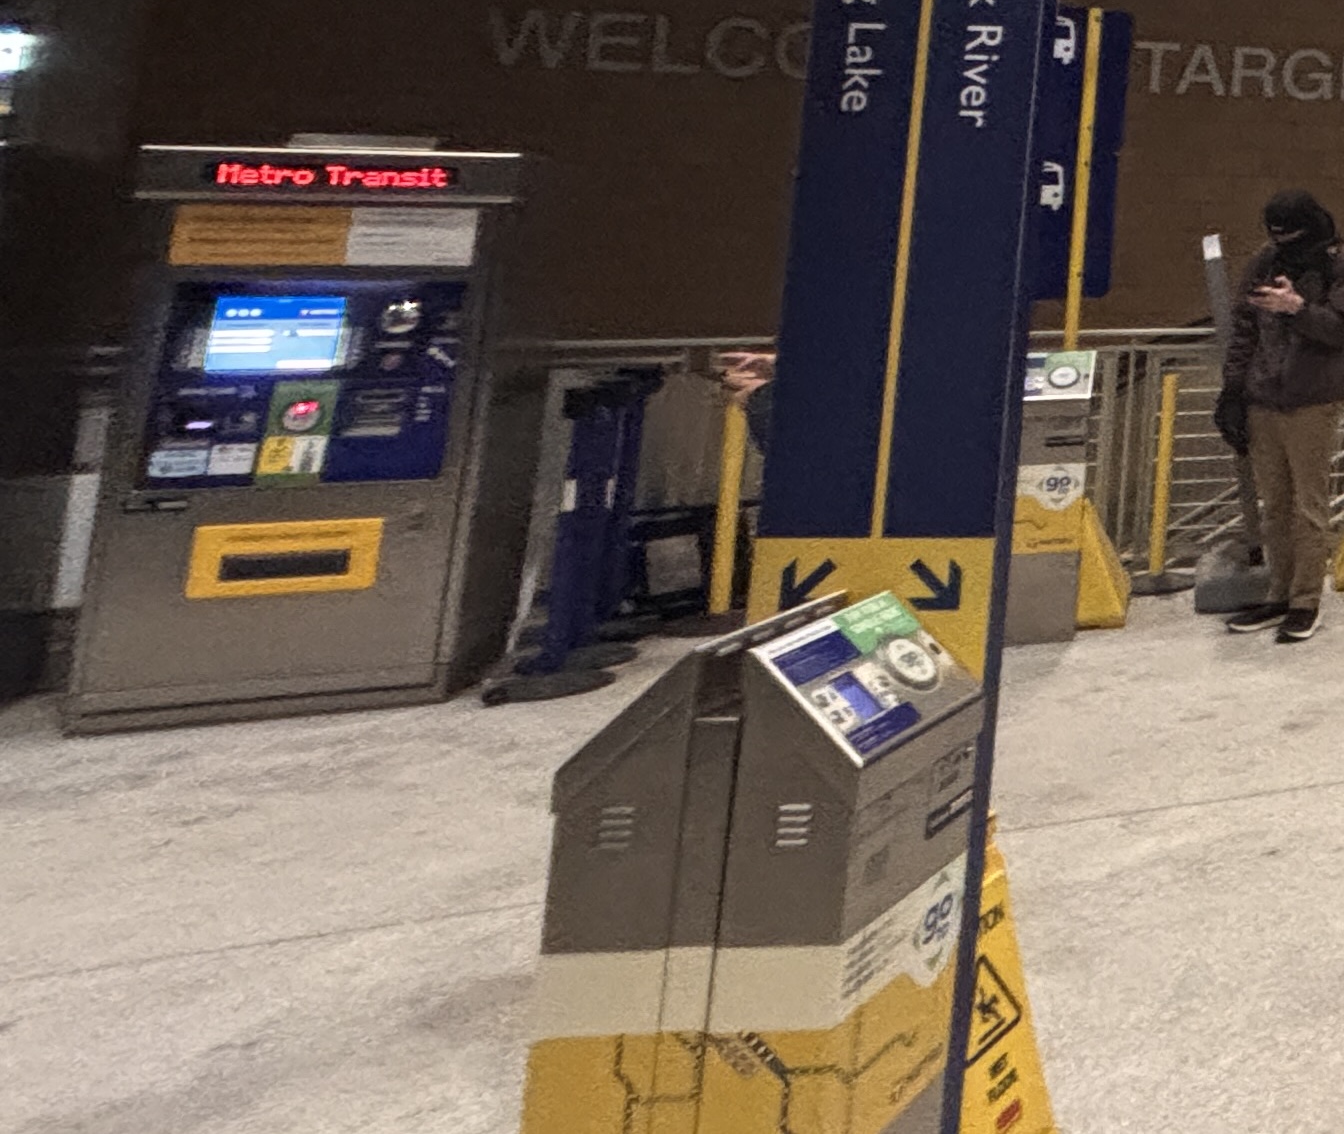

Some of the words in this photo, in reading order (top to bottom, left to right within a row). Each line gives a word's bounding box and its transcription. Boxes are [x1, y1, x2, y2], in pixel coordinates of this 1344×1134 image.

[840, 22, 888, 113] Lake
[958, 24, 1004, 128] River
[216, 163, 315, 185] Metro
[325, 164, 448, 188] Transit
